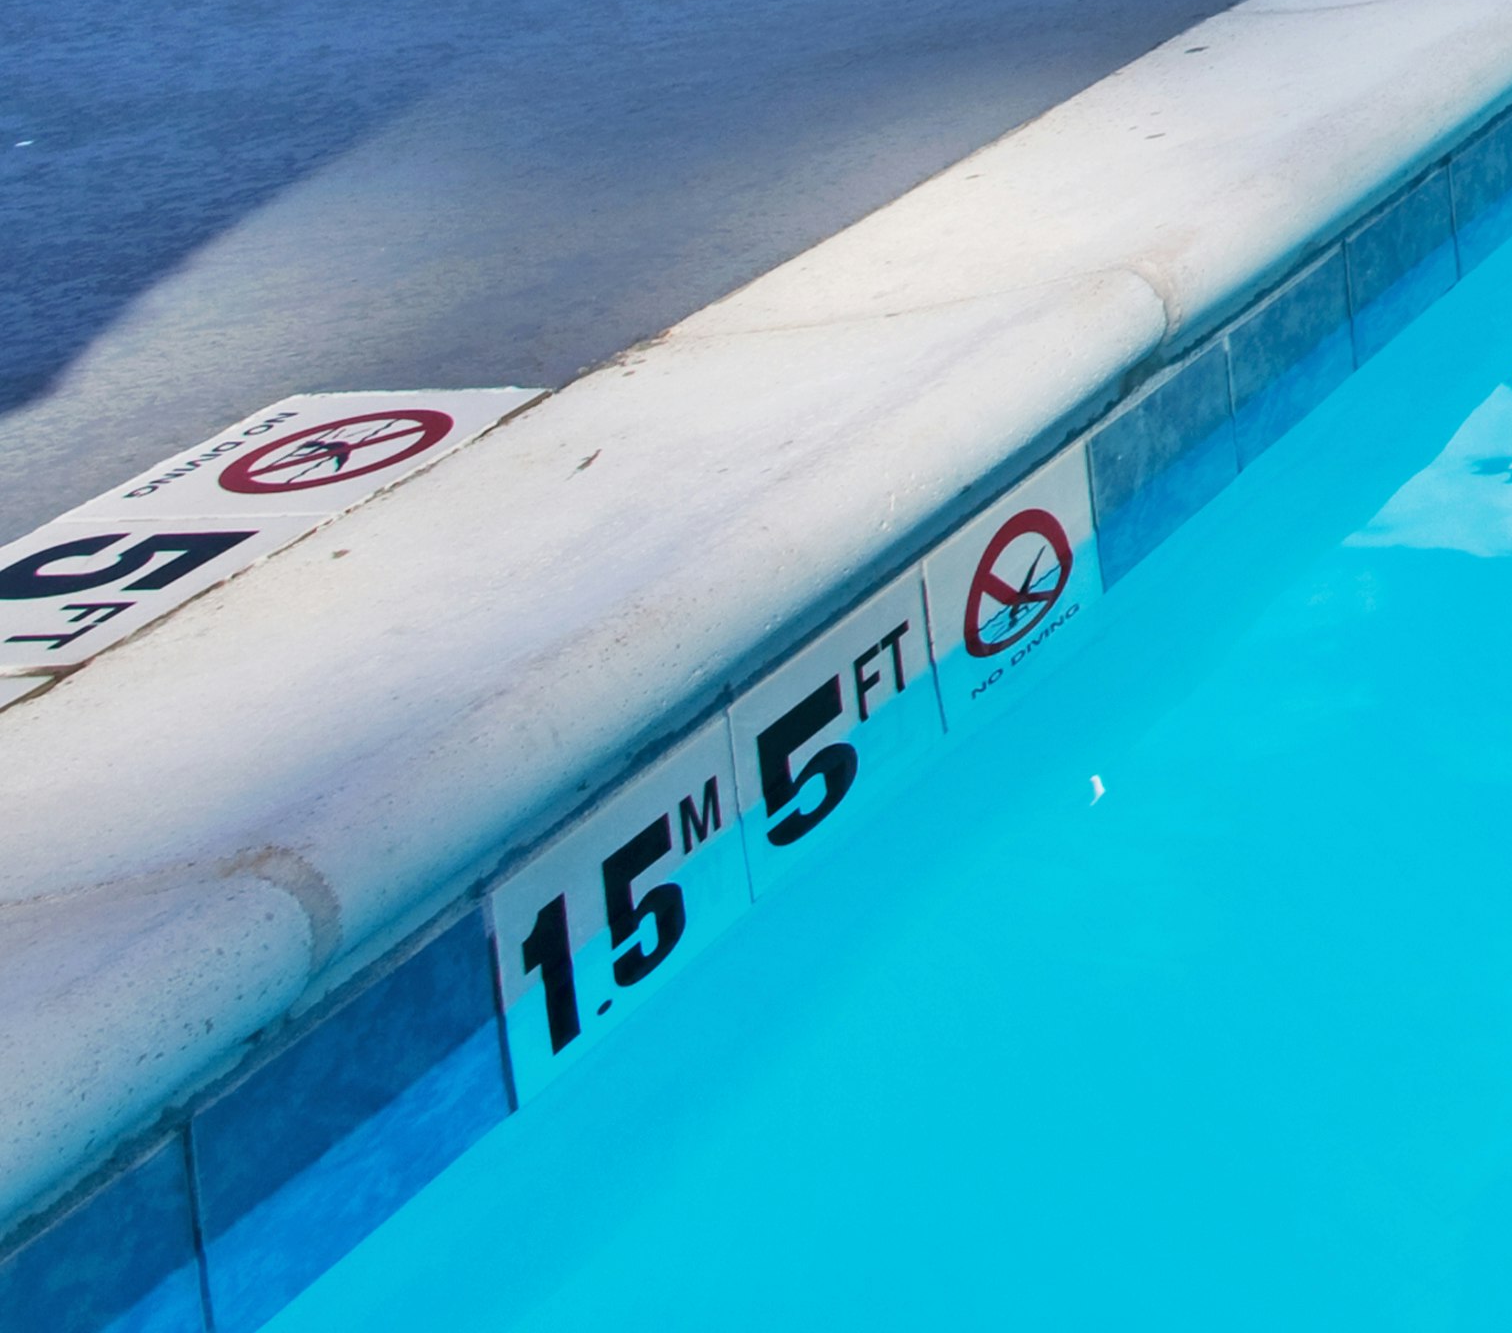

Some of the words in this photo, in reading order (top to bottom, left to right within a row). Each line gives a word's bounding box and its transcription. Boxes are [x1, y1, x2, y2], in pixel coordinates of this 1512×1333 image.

[242, 412, 299, 436] NO
[122, 440, 246, 499] DIVING
[0, 530, 260, 600] 5
[3, 601, 138, 651] FT
[971, 668, 1004, 700] NO
[1010, 603, 1081, 667] DIVING
[756, 673, 859, 847] 5
[853, 619, 909, 724] FT
